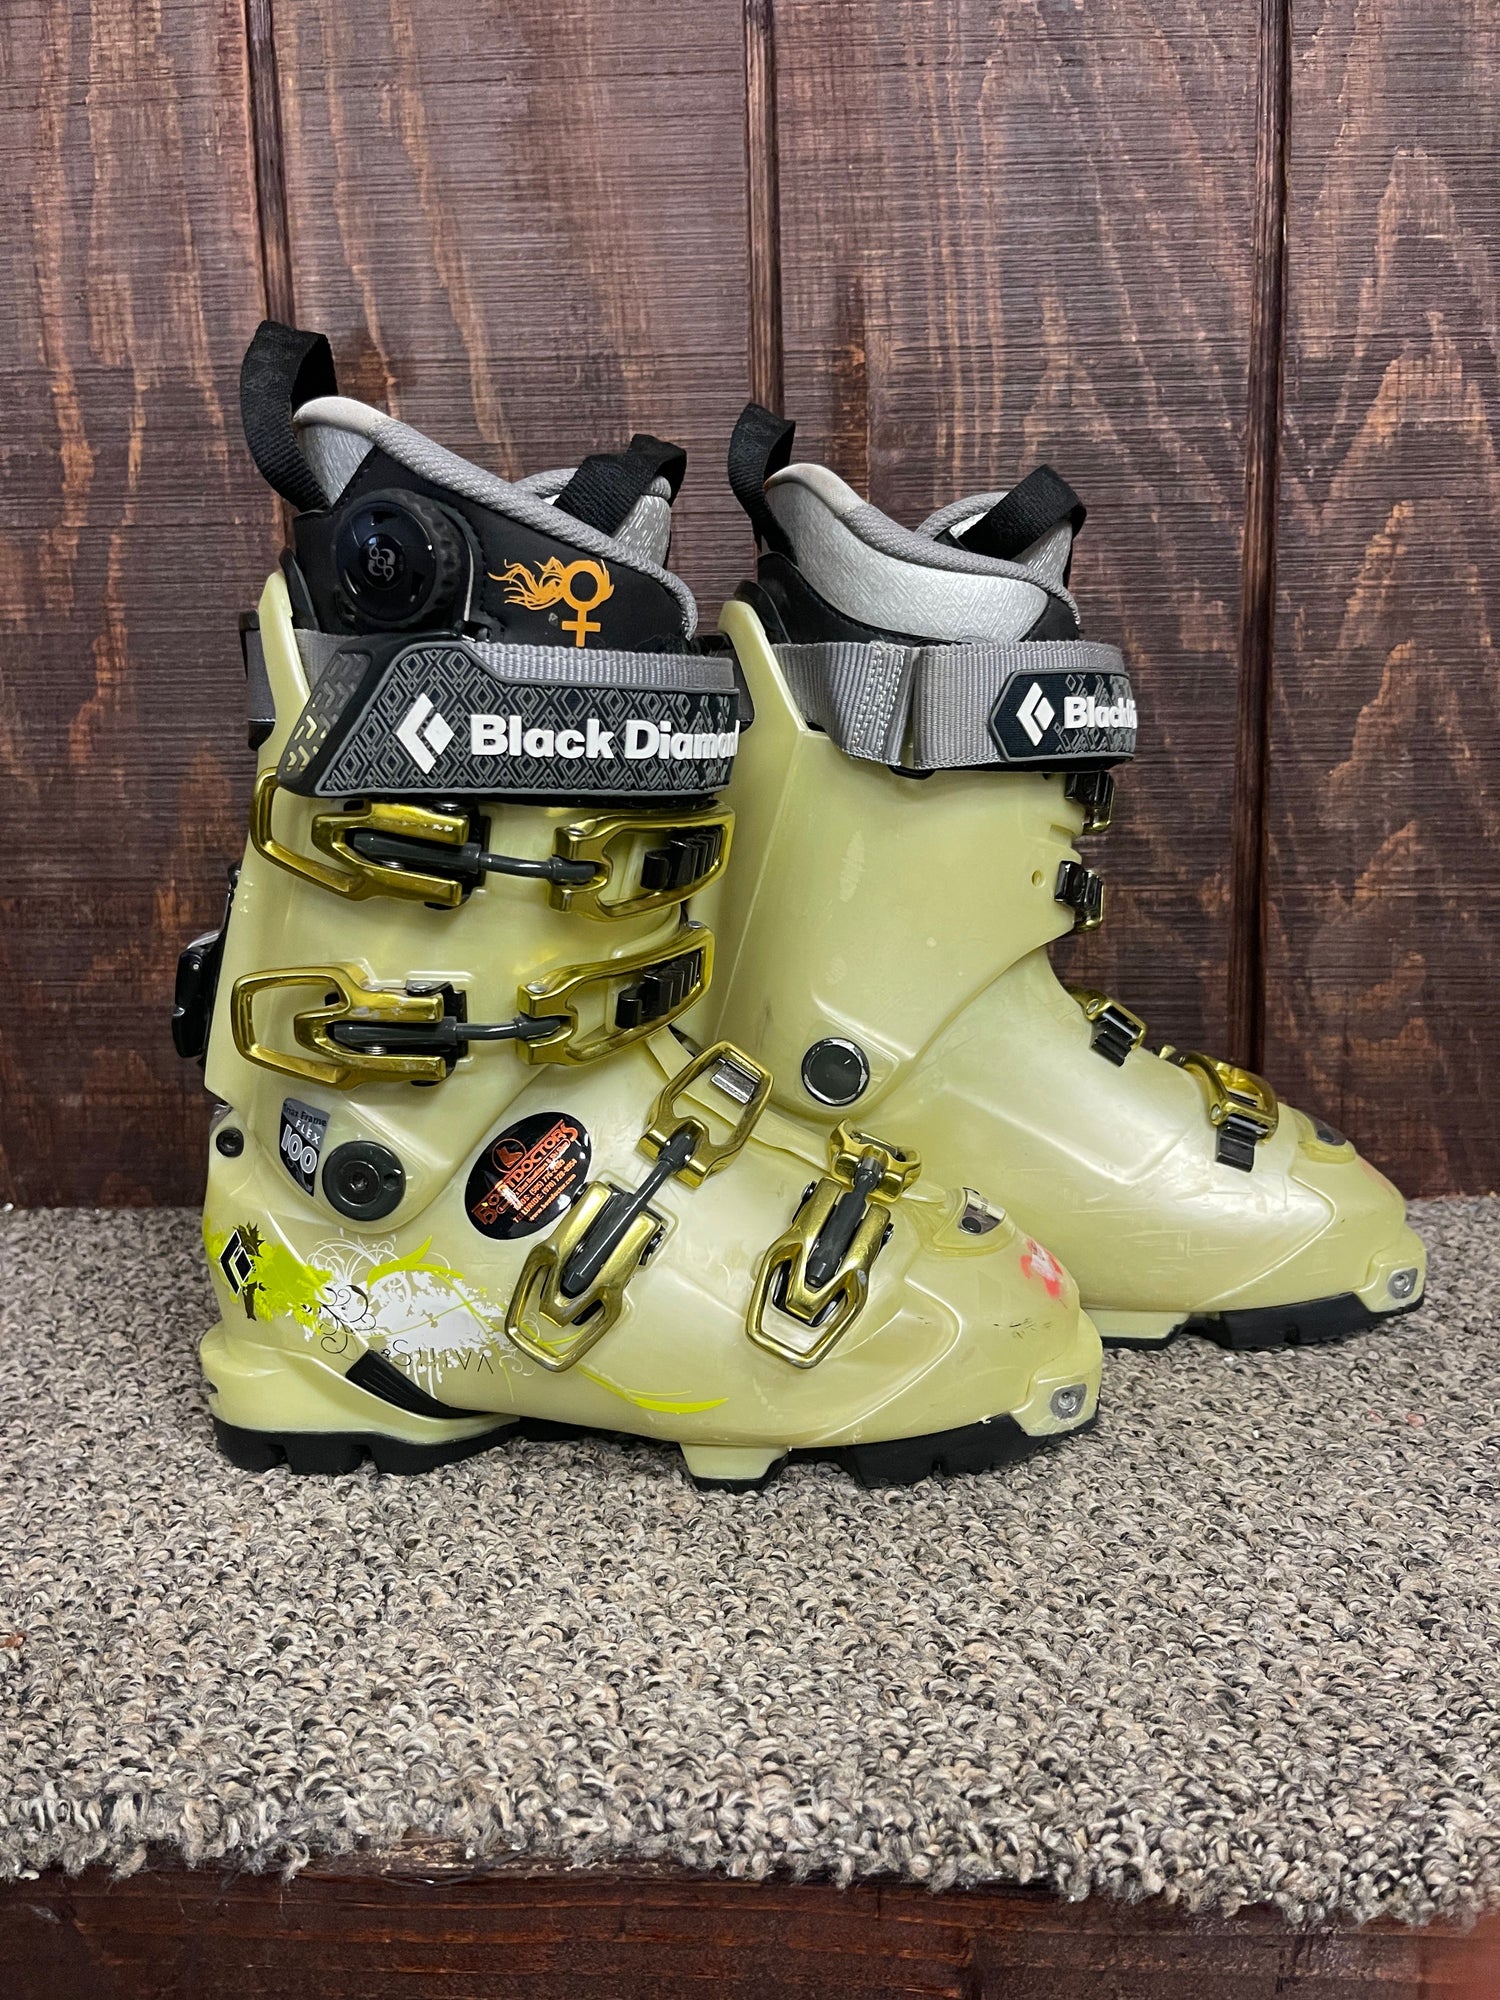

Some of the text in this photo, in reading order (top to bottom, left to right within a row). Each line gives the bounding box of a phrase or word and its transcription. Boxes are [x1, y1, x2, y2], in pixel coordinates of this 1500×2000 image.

[470, 714, 614, 760] Black
[301, 1111, 328, 1127] Frame
[295, 1119, 321, 1145] FLEX
[281, 1123, 317, 1174] 100
[529, 1180, 544, 1196] (505)
[541, 1179, 556, 1195] (970)
